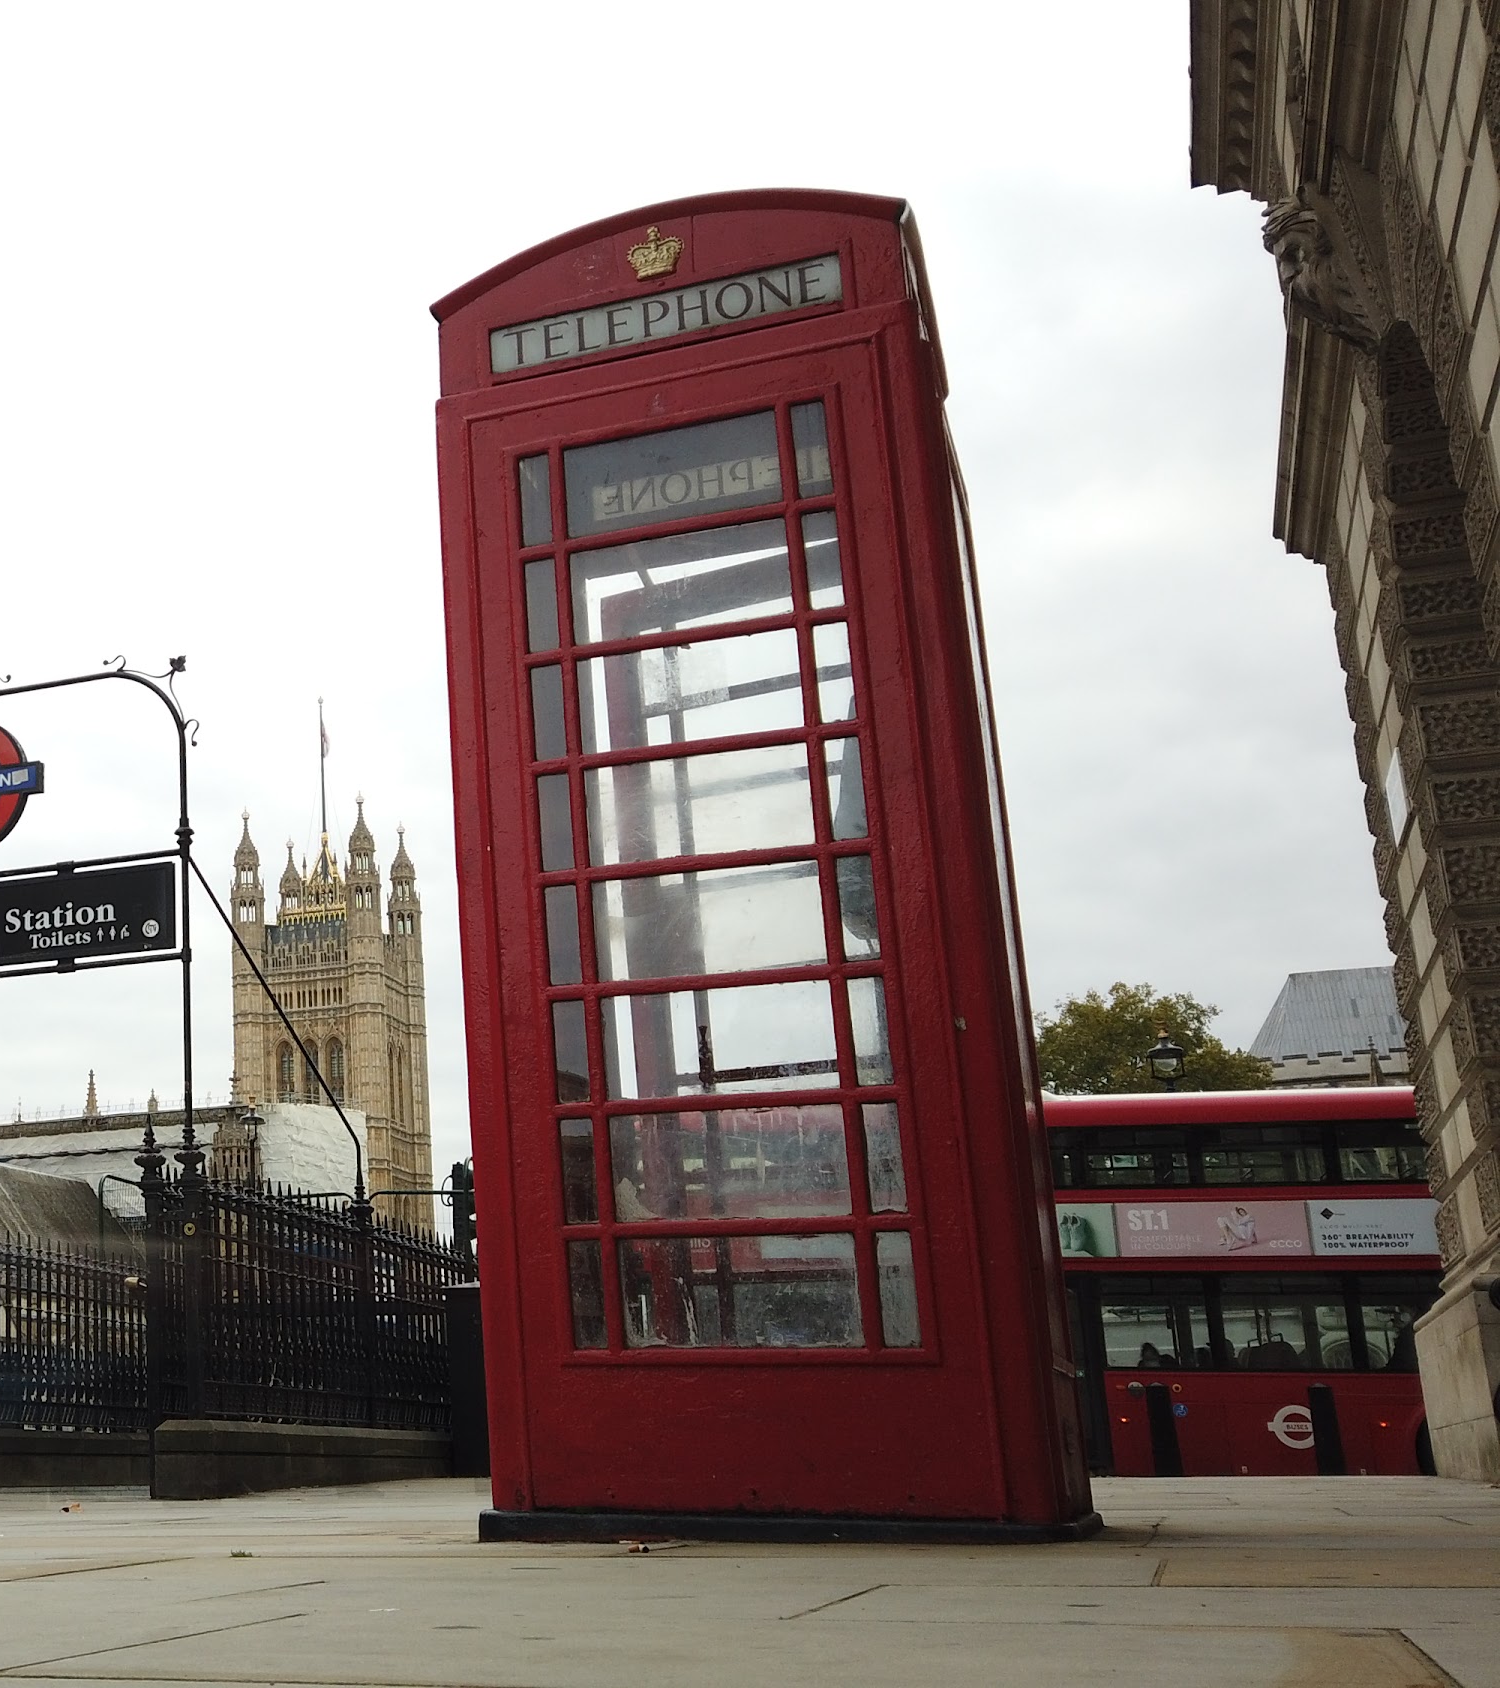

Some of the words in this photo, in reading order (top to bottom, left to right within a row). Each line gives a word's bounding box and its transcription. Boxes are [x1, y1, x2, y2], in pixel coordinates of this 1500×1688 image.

[502, 262, 827, 366] TELEPHONE
[5, 902, 117, 933] Station
[29, 930, 92, 949] Toilets
[1127, 1209, 1169, 1231] ST.1
[1269, 1240, 1302, 1248] ecco
